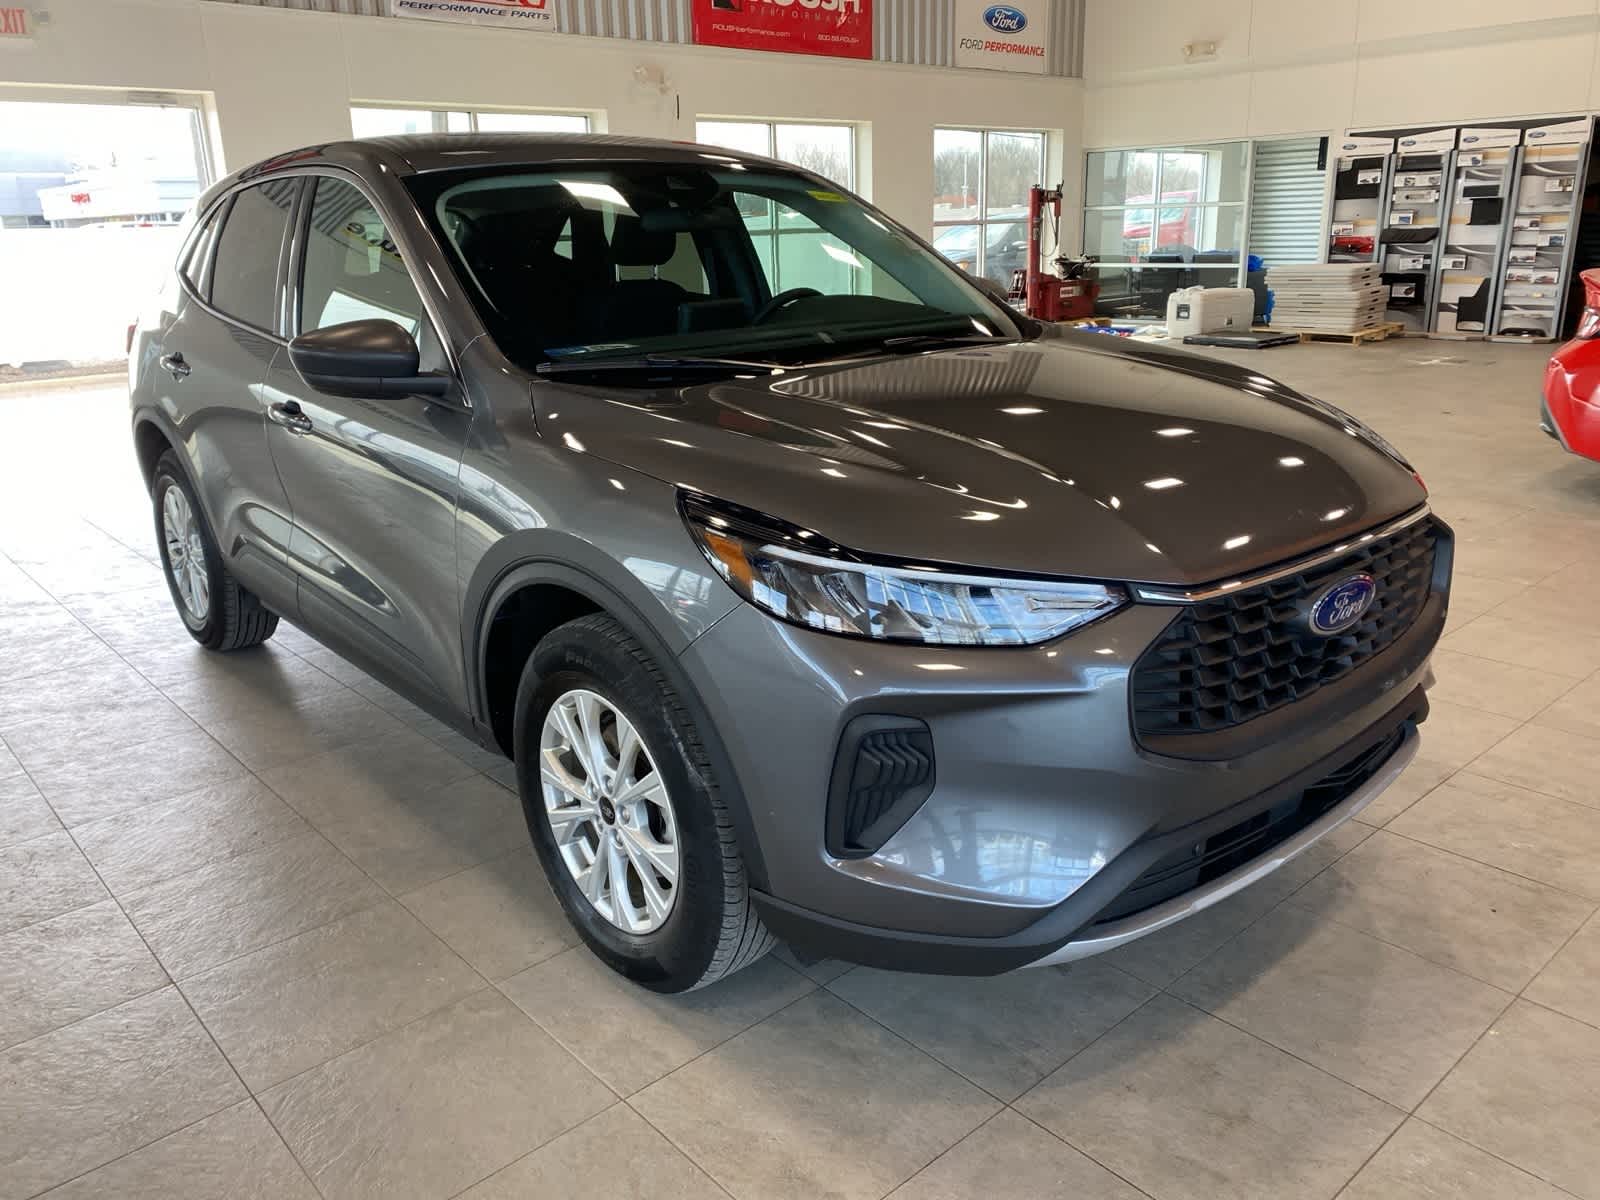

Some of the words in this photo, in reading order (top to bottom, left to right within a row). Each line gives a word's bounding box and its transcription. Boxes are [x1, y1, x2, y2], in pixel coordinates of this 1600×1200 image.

[400, 1, 507, 16] PERFORMANCE
[510, 10, 550, 20] PARTS
[0, 8, 25, 33] XIT
[960, 38, 983, 50] FORD
[984, 41, 1045, 57] PERFORMANCE
